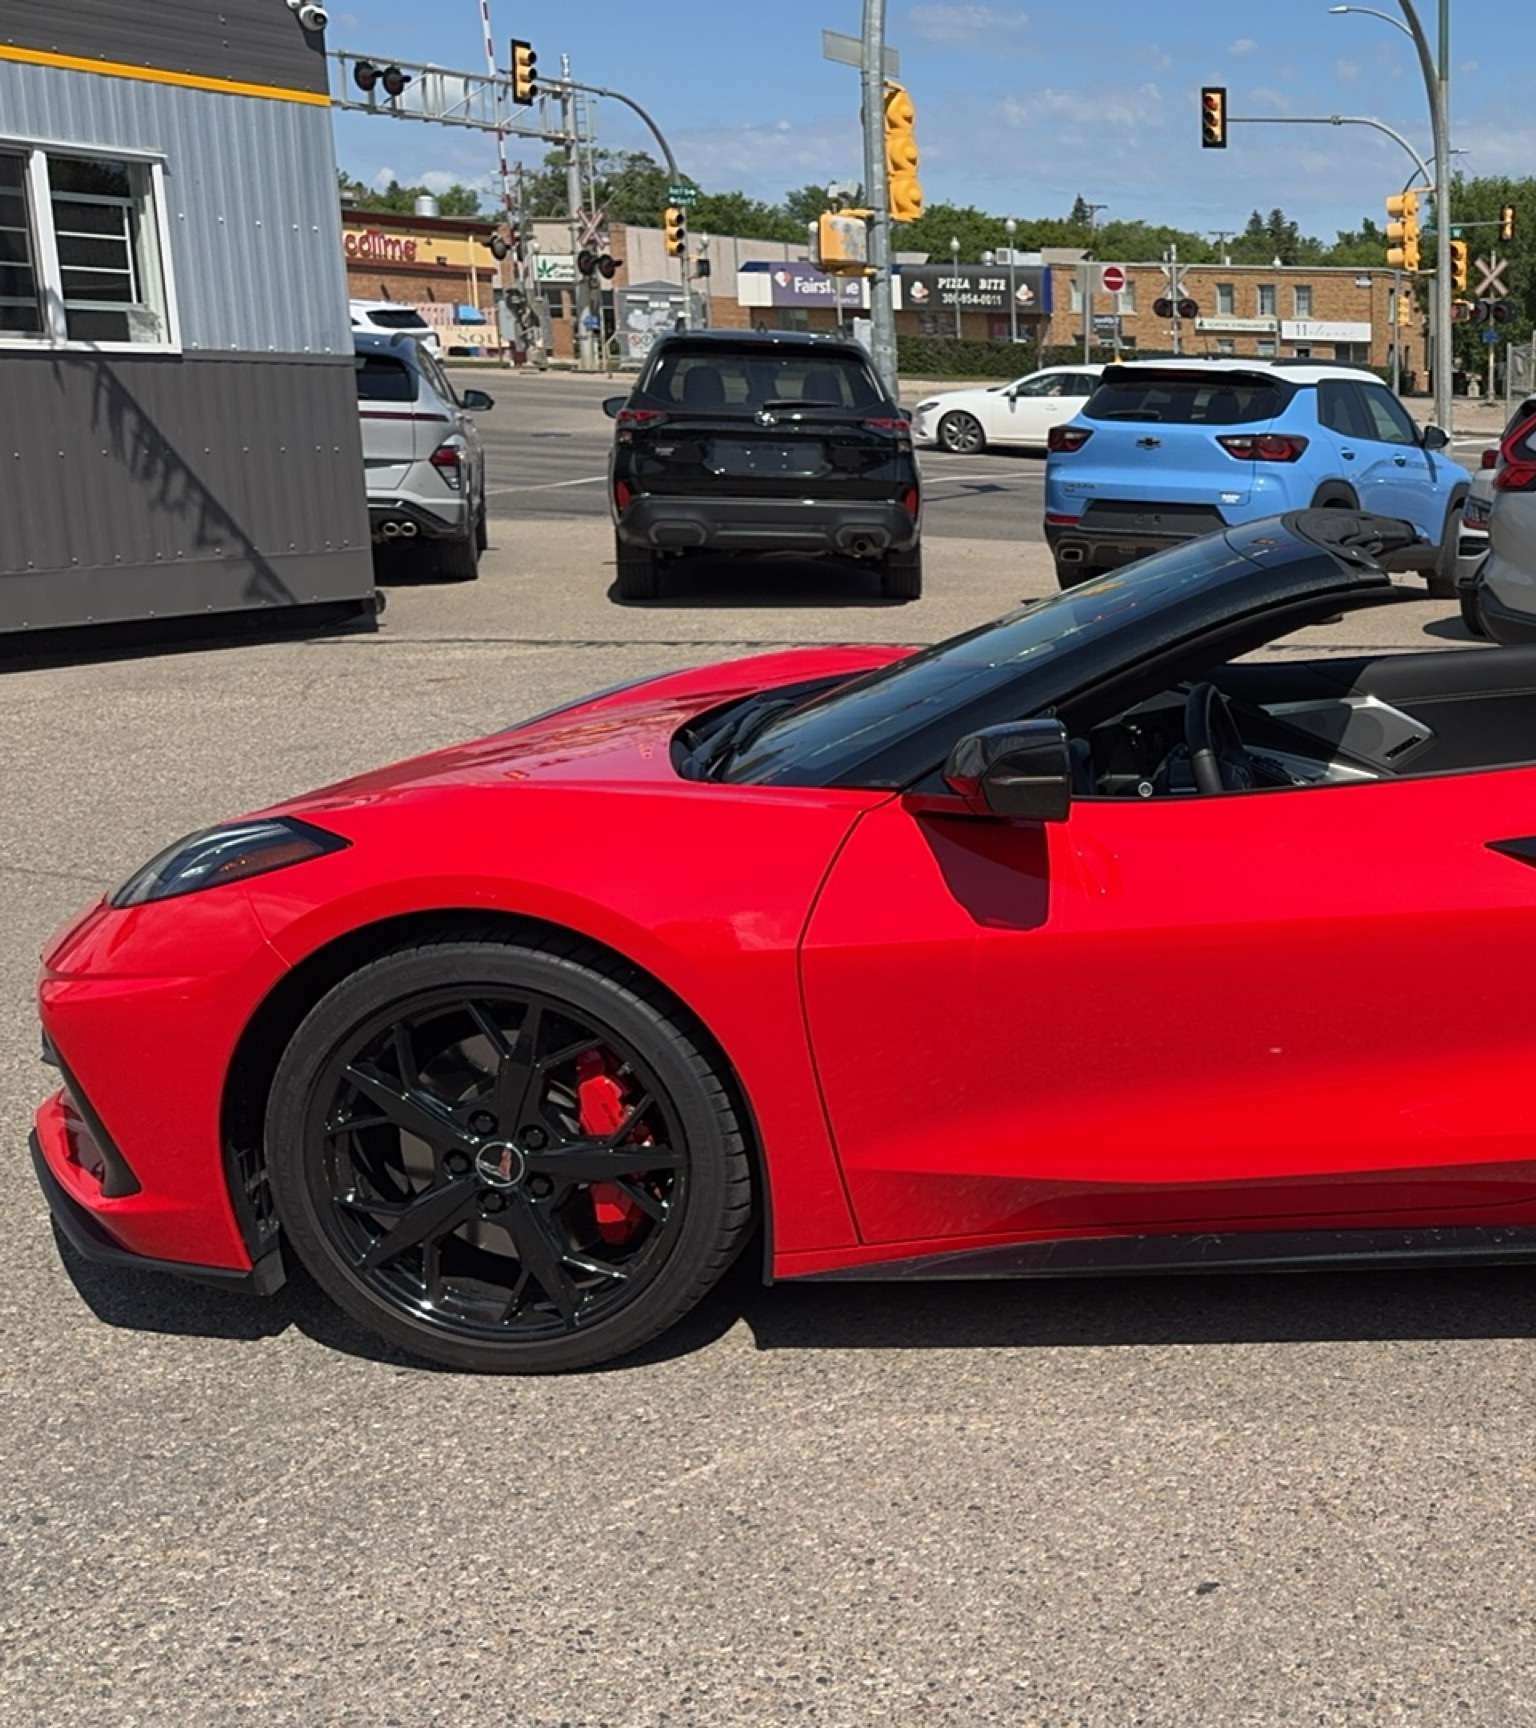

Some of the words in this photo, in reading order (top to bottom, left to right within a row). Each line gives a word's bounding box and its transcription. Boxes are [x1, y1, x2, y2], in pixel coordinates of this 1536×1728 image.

[793, 276, 860, 295] Fairste
[937, 277, 971, 289] PIZZA
[978, 278, 1007, 291] BITE
